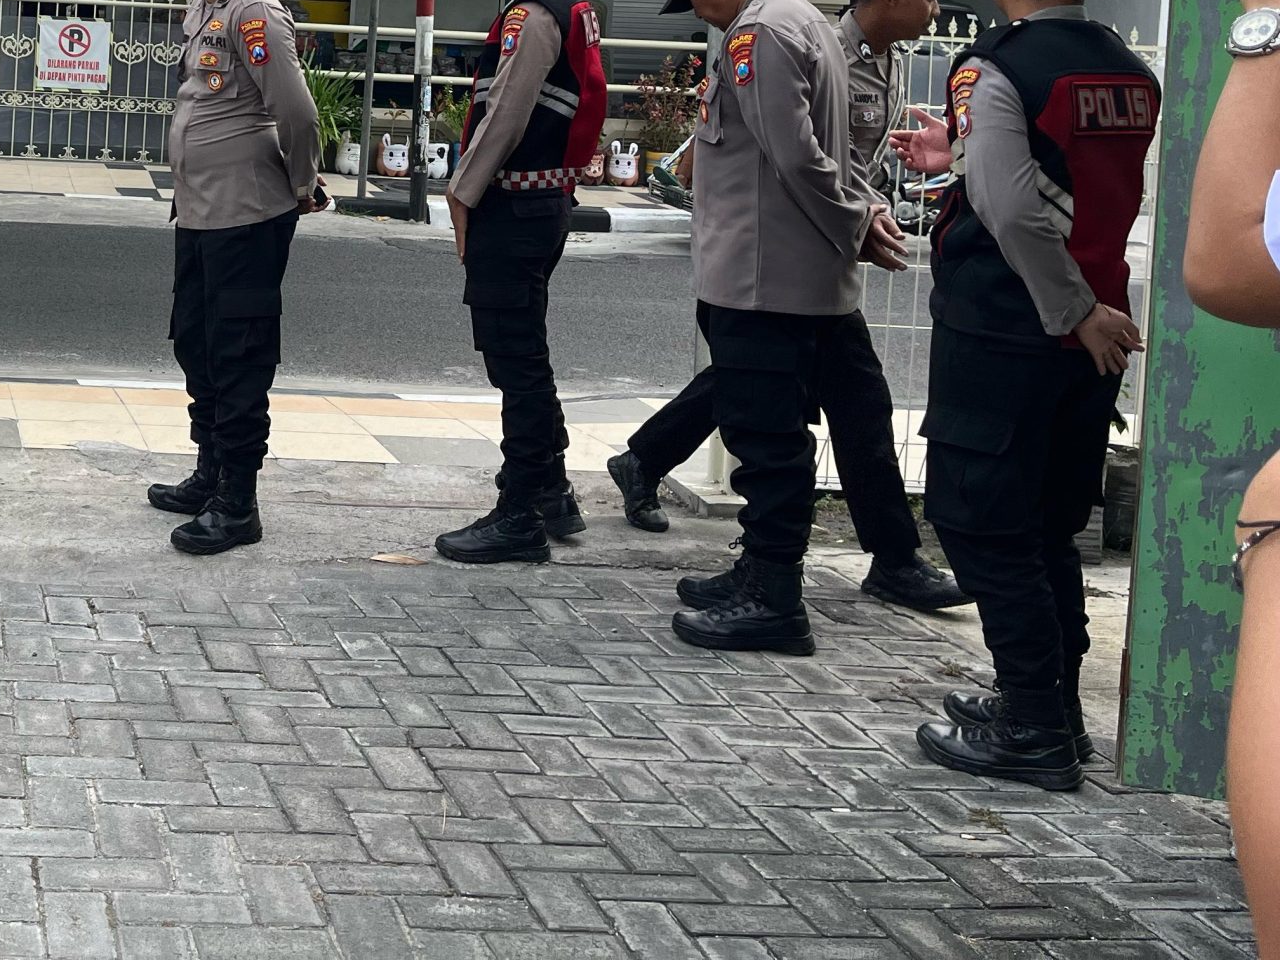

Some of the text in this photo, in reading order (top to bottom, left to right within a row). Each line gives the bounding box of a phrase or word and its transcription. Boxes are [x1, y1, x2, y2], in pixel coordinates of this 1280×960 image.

[201, 35, 226, 49] POLRI
[78, 60, 100, 71] PARKIR
[1077, 87, 1152, 129] POLISI
